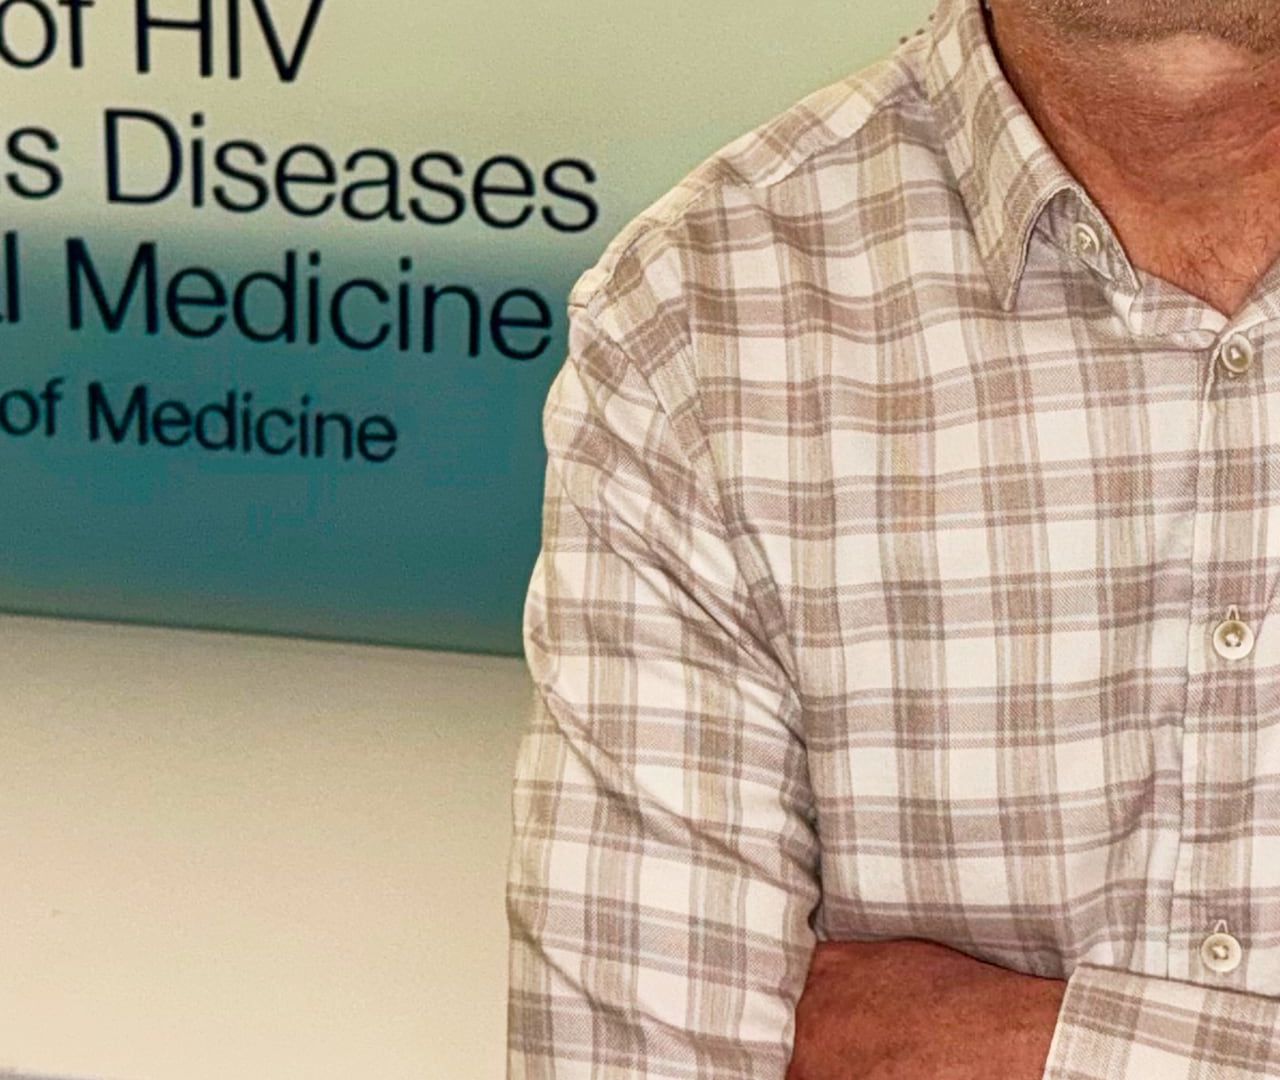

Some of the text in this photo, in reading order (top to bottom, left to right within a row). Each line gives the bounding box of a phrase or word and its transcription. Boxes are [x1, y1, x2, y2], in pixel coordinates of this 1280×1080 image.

[104, 108, 599, 234] Diseases
[66, 237, 554, 362] Medicine
[88, 381, 398, 464] Medicine
